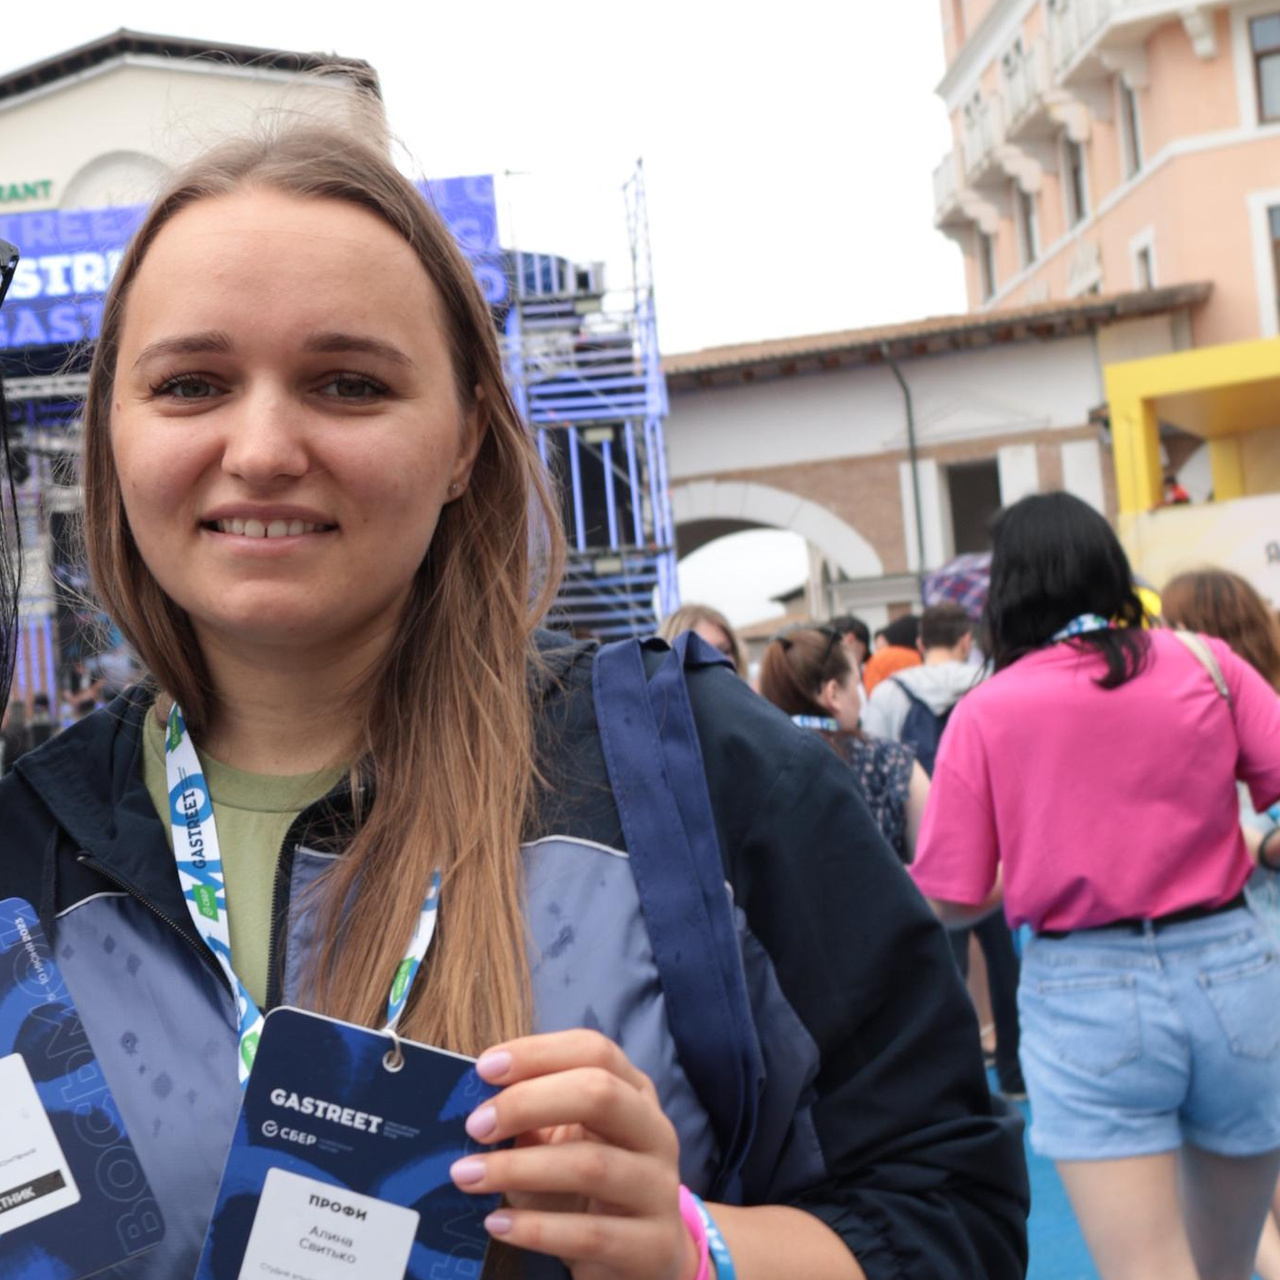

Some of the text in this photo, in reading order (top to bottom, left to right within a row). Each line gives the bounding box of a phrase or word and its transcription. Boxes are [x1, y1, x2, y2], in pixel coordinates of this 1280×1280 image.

[182, 789, 207, 870] GASTREET
[270, 1088, 383, 1134] GASTREET
[279, 1127, 317, 1146] СБЕР
[308, 1193, 368, 1222] ПРОФИ
[309, 1225, 354, 1248] Алина
[299, 1237, 357, 1265] Свитько
